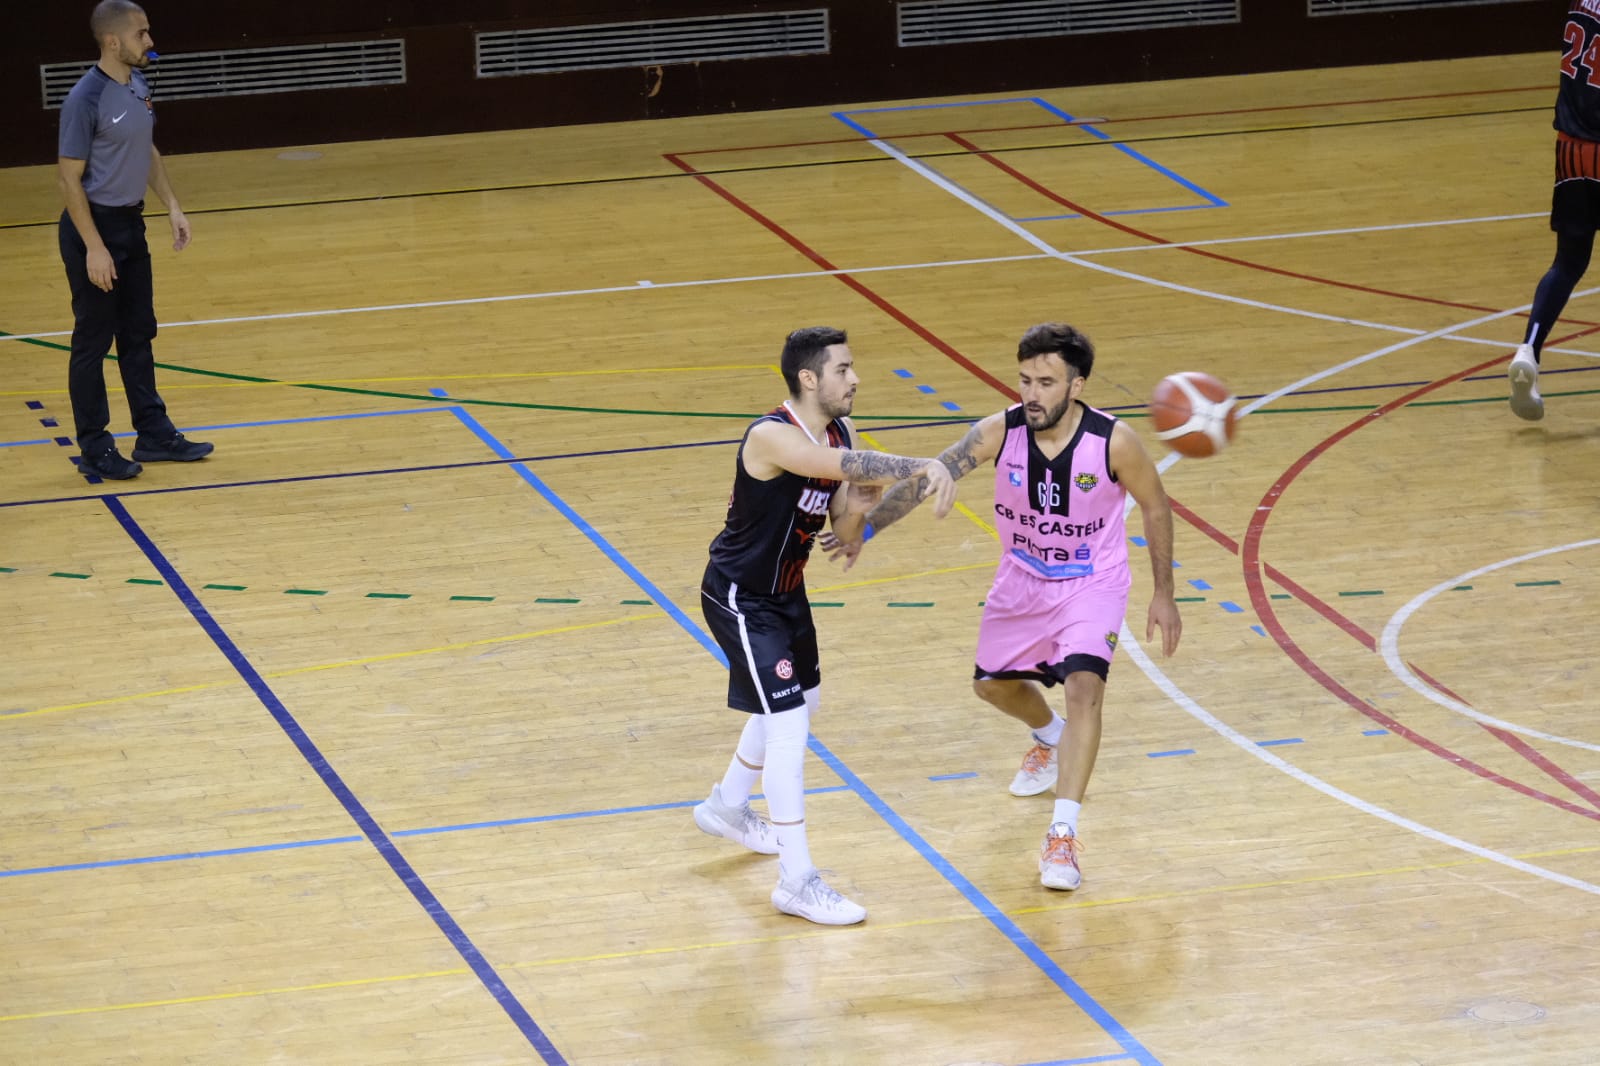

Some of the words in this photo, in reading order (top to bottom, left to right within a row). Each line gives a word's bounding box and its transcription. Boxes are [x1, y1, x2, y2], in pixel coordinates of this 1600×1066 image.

[1560, 21, 1600, 88] 24
[1037, 481, 1061, 507] 66
[995, 503, 1015, 520] CB
[1020, 514, 1036, 528] ES
[1038, 517, 1105, 537] CASTELL
